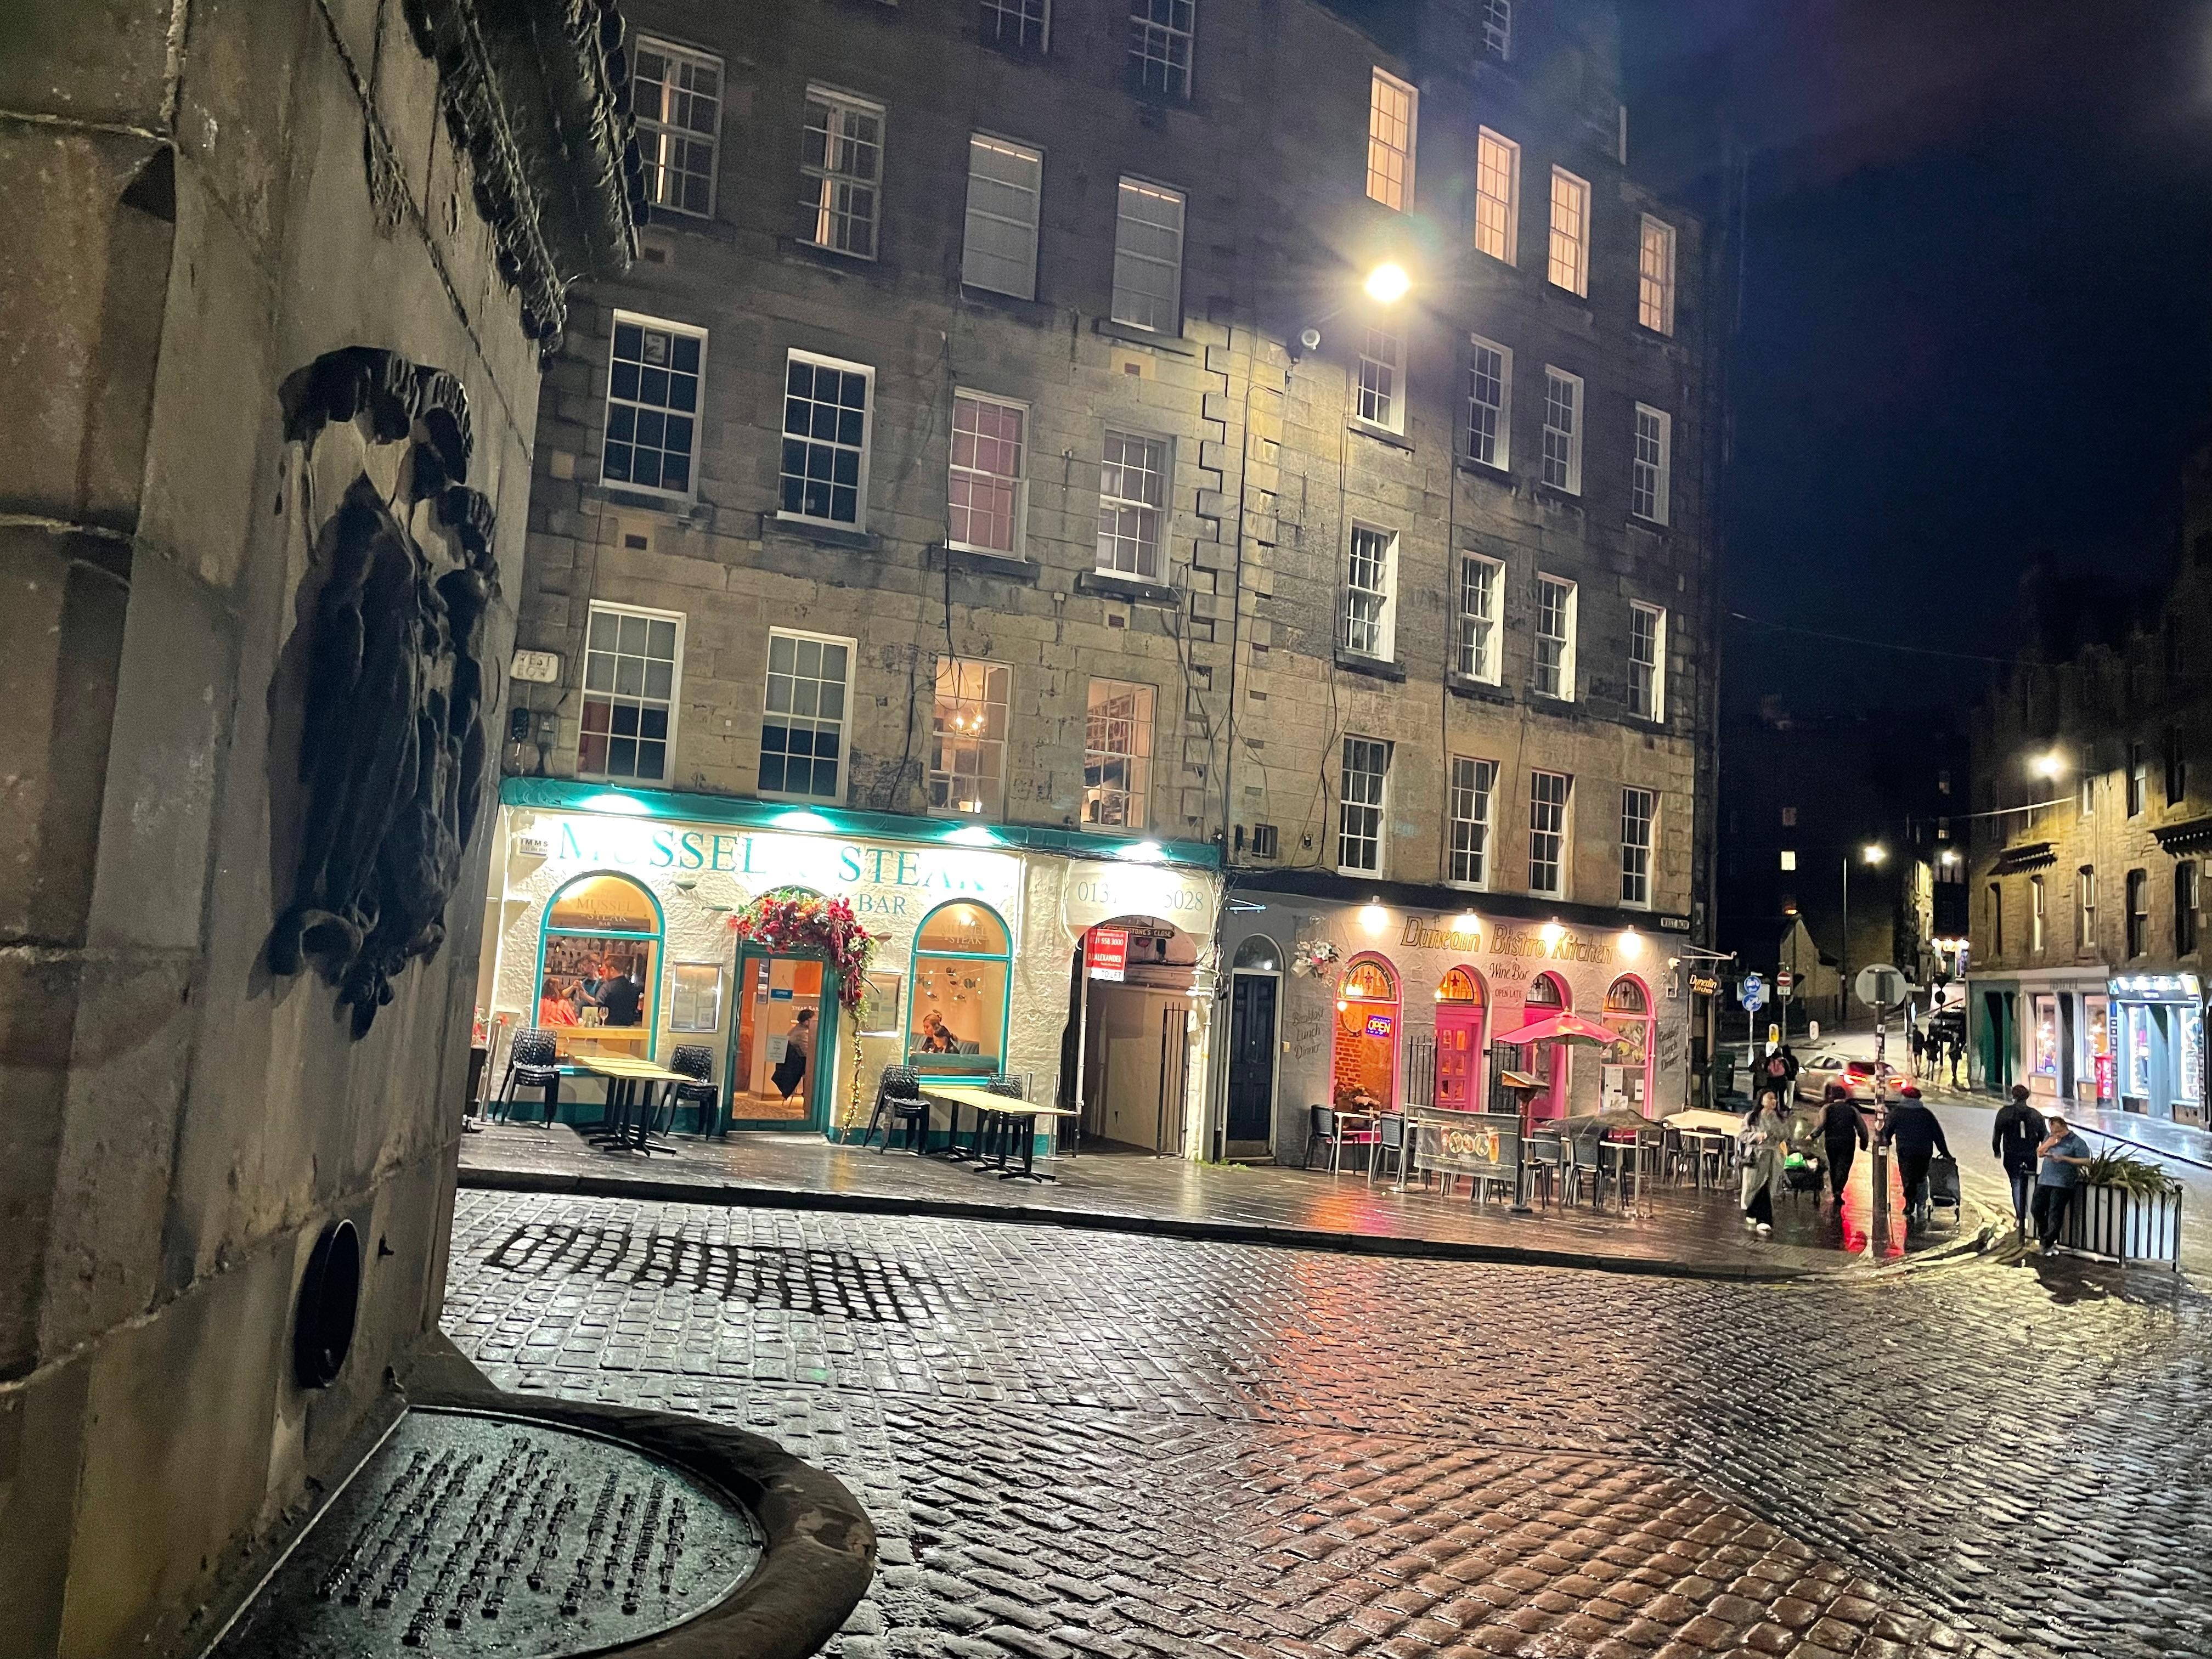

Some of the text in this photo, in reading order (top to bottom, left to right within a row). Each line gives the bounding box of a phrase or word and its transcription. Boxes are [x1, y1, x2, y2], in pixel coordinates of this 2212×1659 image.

[557, 823, 766, 873] MSSEL
[1078, 881, 1117, 904] 013
[577, 899, 633, 911] MUSSEL
[858, 894, 906, 915] BAR
[587, 912, 627, 922] STEAK
[950, 936, 982, 945] STEAK
[1154, 930, 1172, 938] CLOSE
[1489, 924, 1546, 958] Bistro
[1551, 930, 1613, 964] Kitchen
[1094, 953, 1122, 963] ALEXANDER
[1489, 962, 1530, 980] Wine Bar
[1689, 974, 1718, 989] Dunedin
[1495, 989, 1522, 998] OPEN LATE
[1296, 1023, 1321, 1041] Lunch
[1368, 1019, 1391, 1034] OPEN
[1294, 1043, 1322, 1060] Dinner
